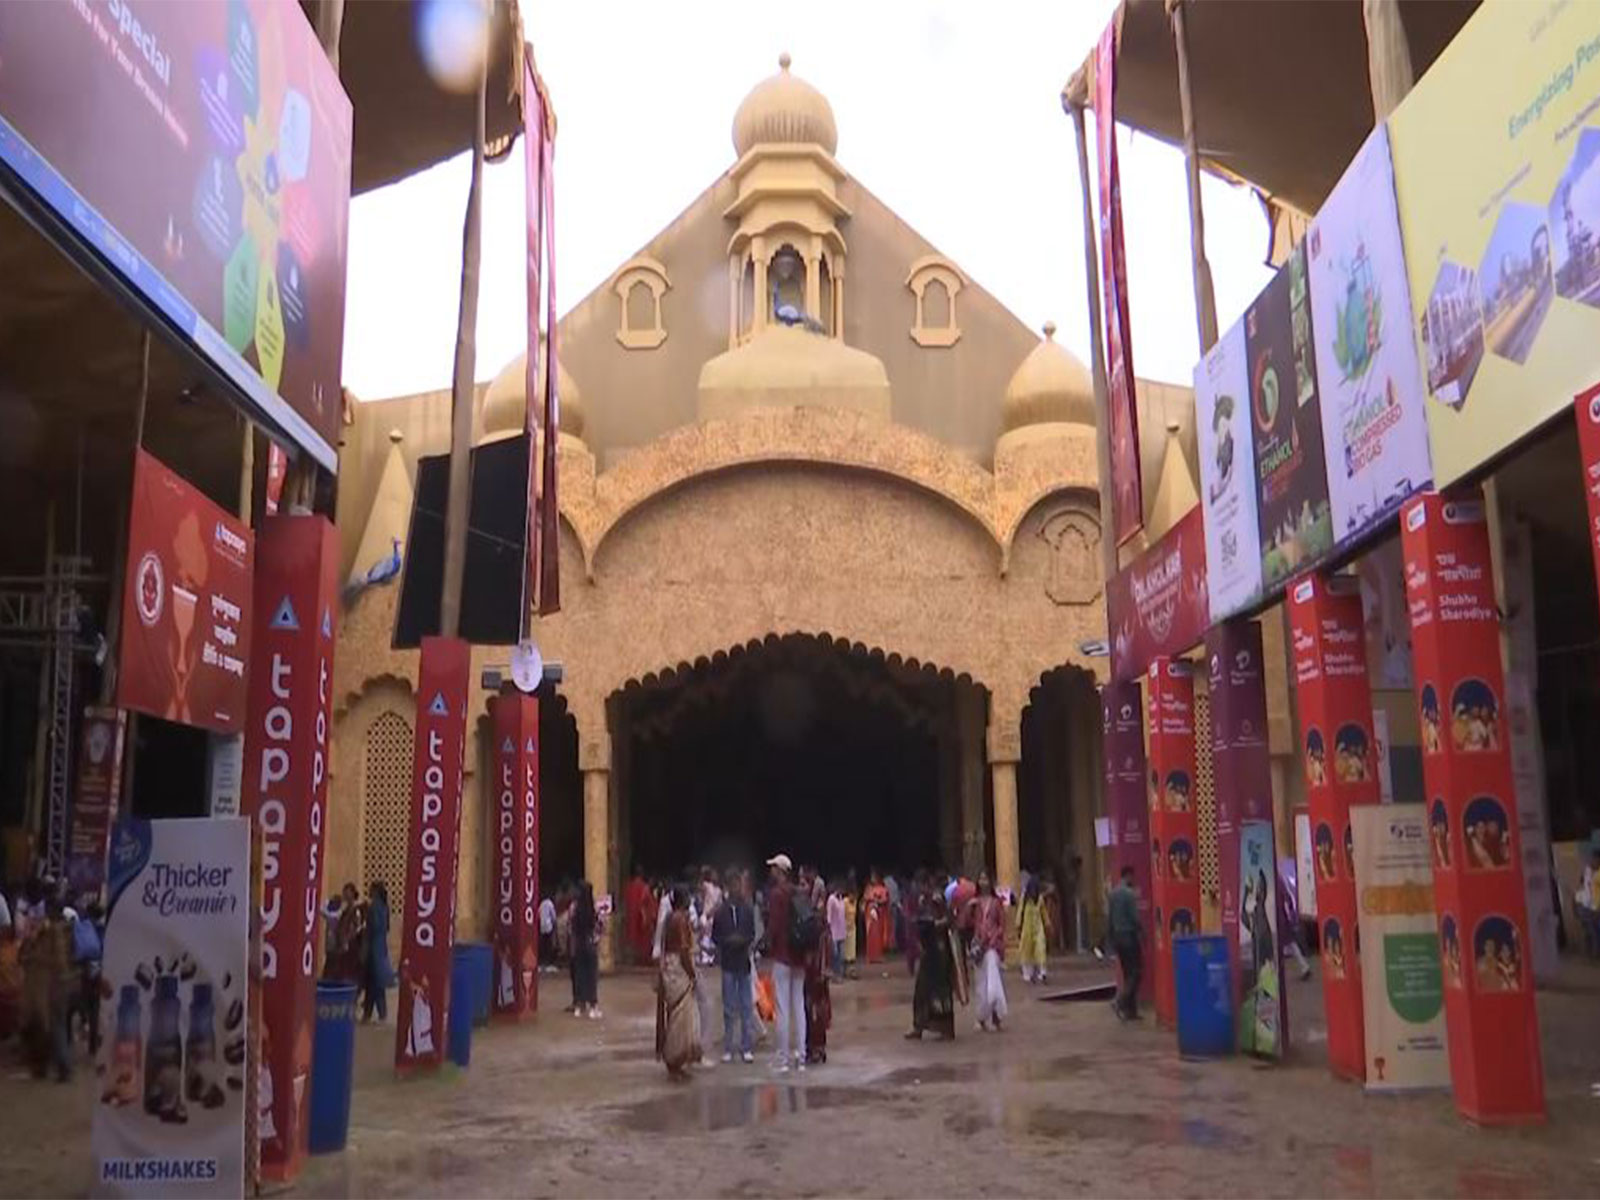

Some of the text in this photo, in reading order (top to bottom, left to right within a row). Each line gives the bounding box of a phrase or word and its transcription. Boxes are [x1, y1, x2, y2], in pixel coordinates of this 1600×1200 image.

[142, 880, 159, 907] &
[151, 862, 233, 888] Thicker
[259, 653, 292, 979] tapasya
[302, 656, 328, 976] tapasya
[415, 730, 444, 947] tapasya
[500, 763, 514, 925] tapasya
[525, 762, 535, 925] tapasya
[103, 1160, 217, 1180] MILKSHAKES
